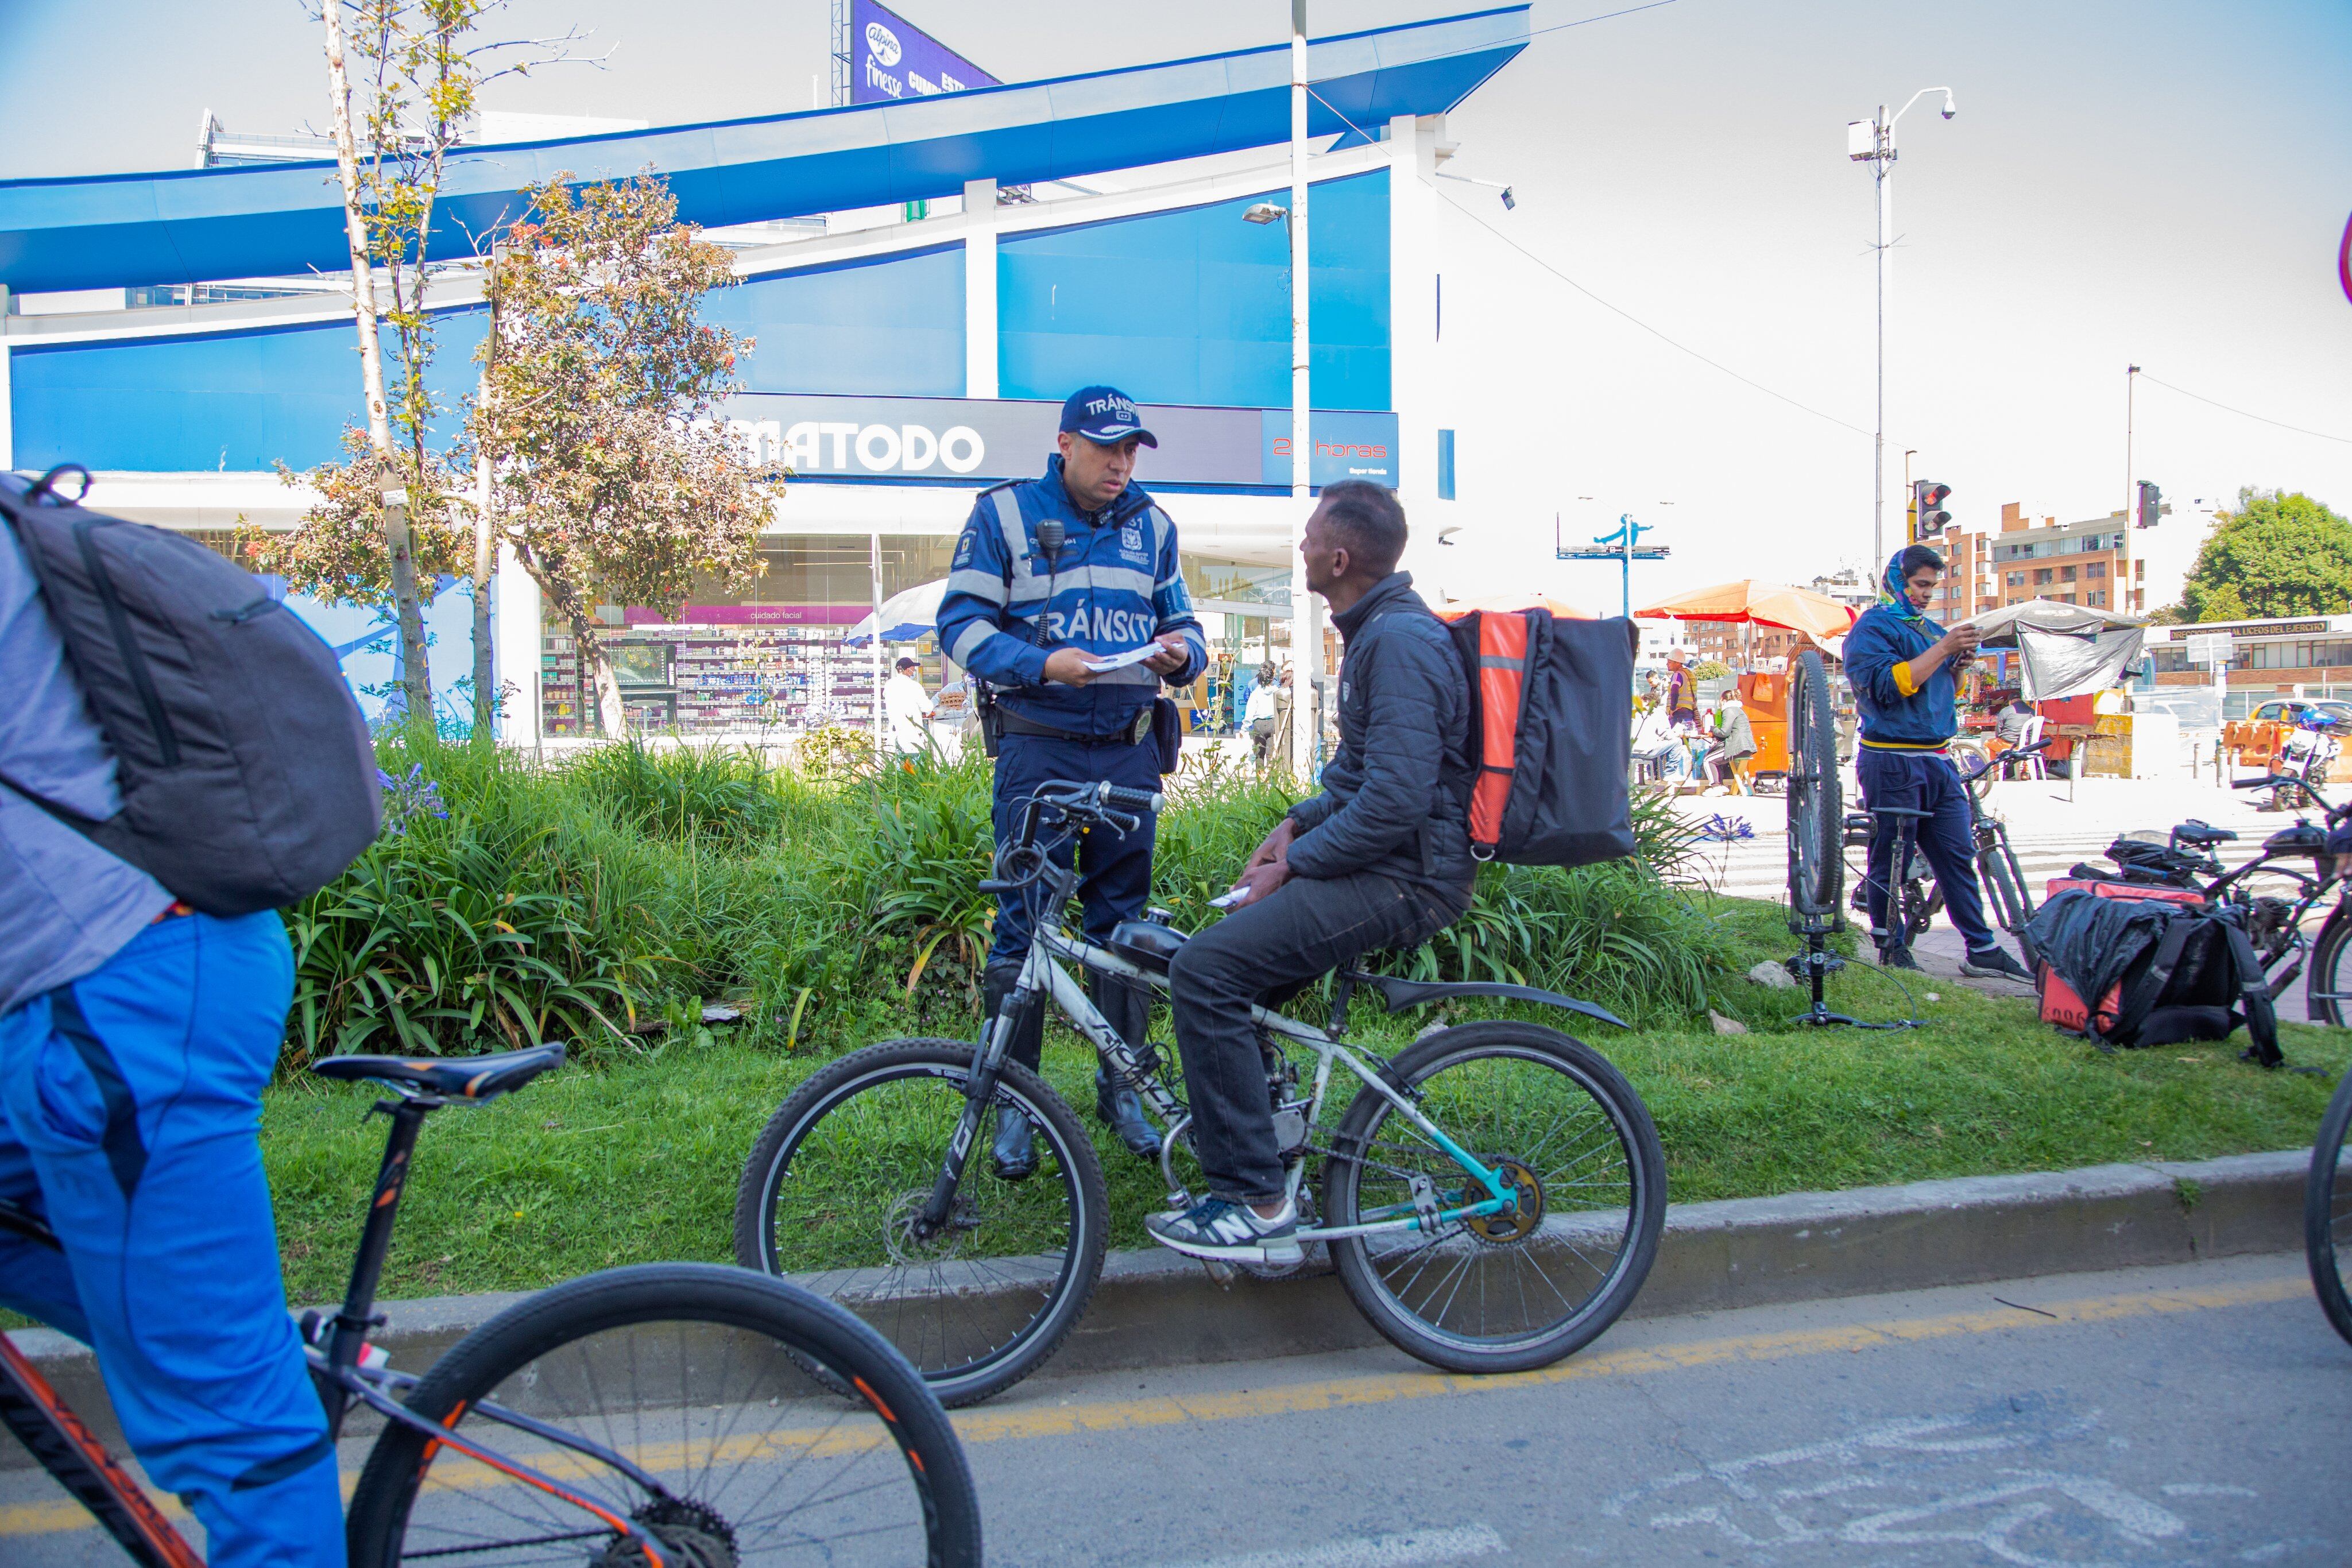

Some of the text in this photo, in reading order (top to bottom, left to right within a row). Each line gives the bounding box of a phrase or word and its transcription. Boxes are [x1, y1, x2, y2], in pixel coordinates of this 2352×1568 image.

[868, 26, 899, 55] alpina
[865, 53, 903, 98] finesse
[1272, 438, 1387, 458] 2 horas
[782, 611, 802, 619] facial
[2242, 626, 2269, 636] LICEOS
[2270, 625, 2285, 634] DEL
[2286, 622, 2324, 633] EJERCITO
[1210, 1213, 1255, 1246] N
